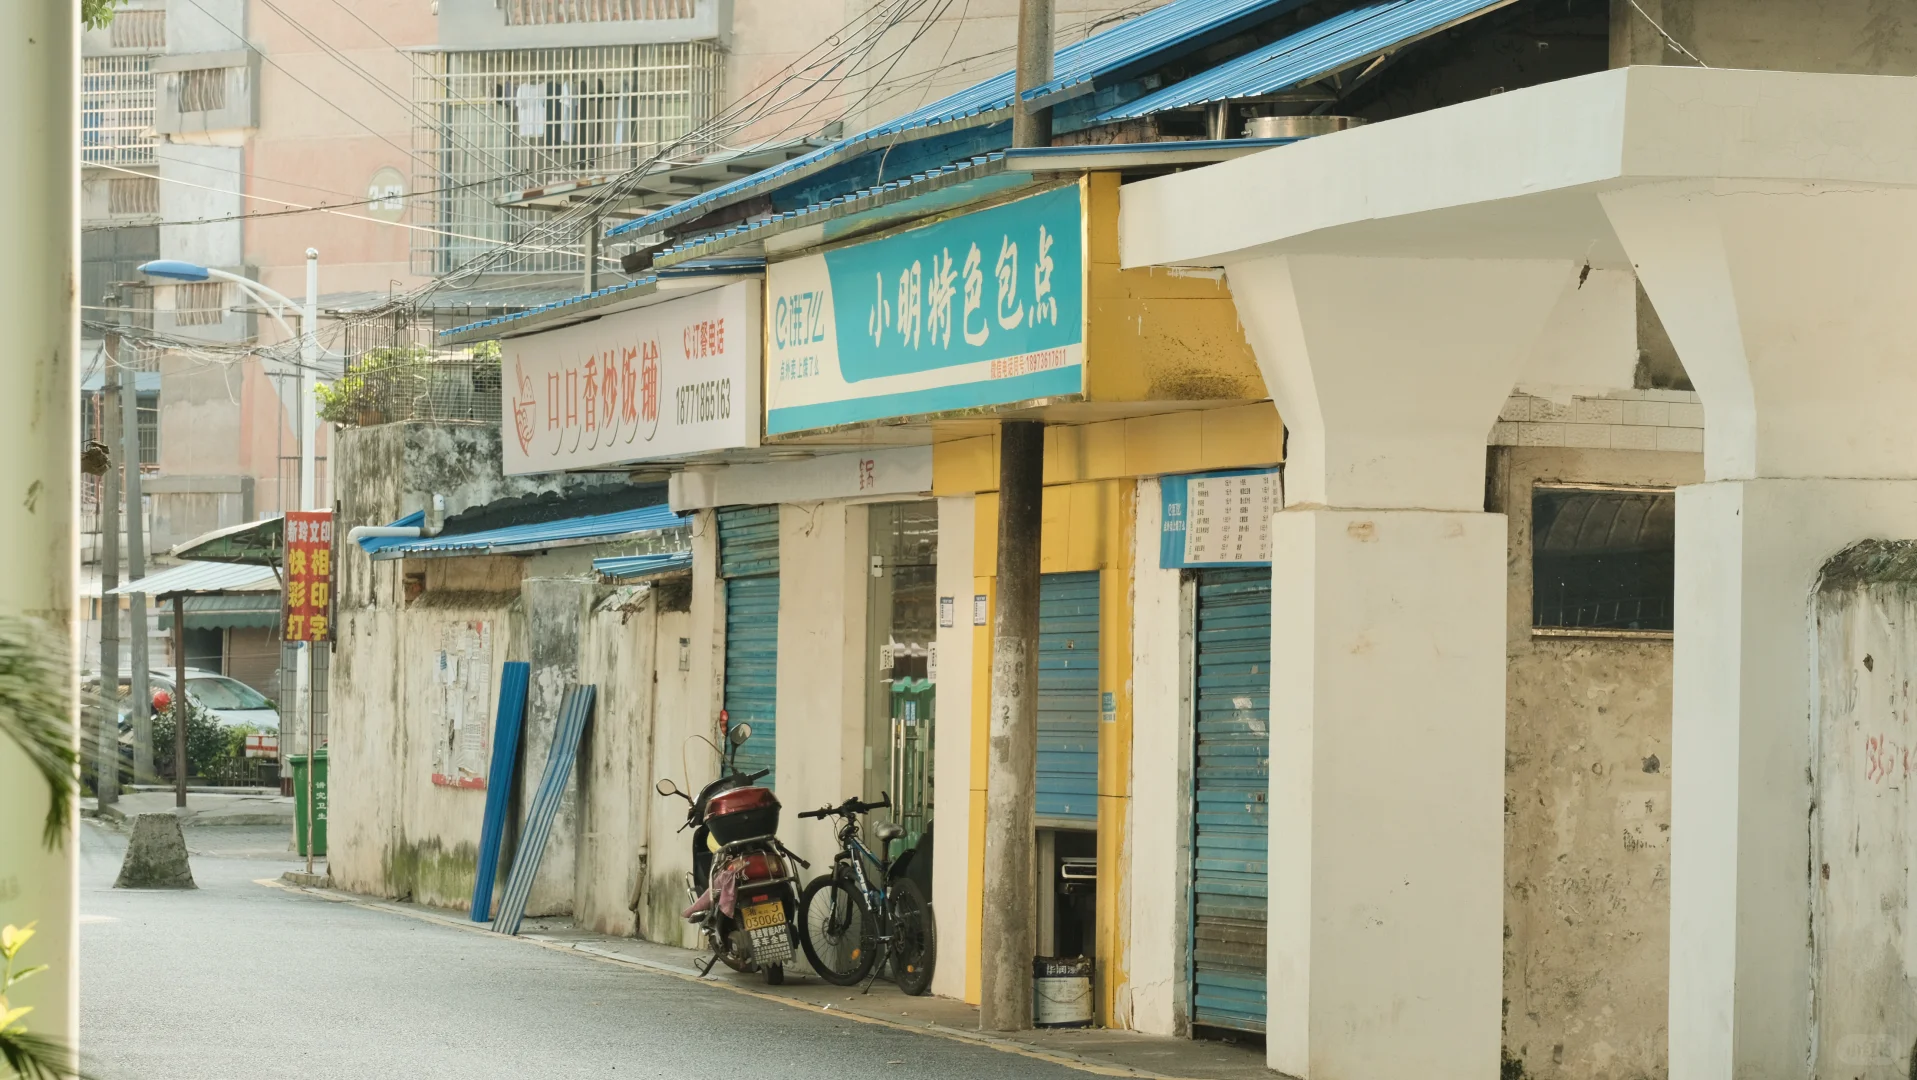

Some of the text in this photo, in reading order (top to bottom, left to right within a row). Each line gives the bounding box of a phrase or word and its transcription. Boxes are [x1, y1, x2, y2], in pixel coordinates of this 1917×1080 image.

[869, 223, 1058, 351] 小明特色包点
[693, 318, 724, 360] 订餐电话
[547, 339, 659, 433] 口口香炒饭铺
[676, 377, 730, 426] 18771865163
[289, 548, 329, 576] 快相
[288, 580, 328, 608] 彩印
[286, 613, 328, 641] 打字
[315, 781, 327, 821] 讲究卫生
[745, 912, 785, 929] 030060
